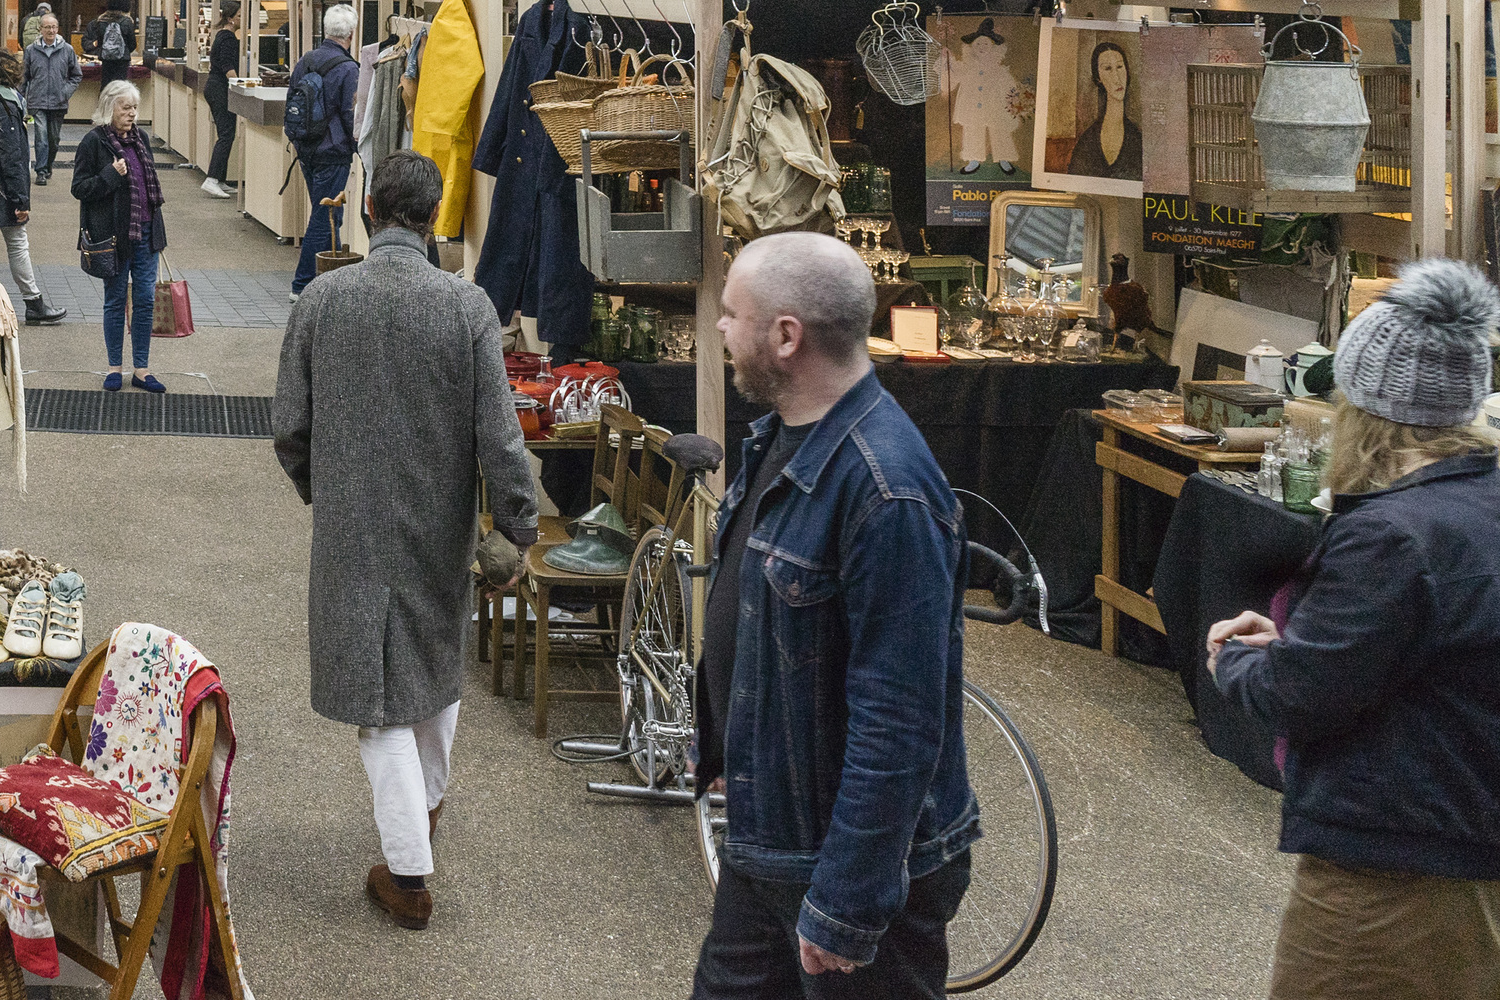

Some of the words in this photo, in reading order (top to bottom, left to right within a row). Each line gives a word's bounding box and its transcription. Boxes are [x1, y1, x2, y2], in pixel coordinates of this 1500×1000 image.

[952, 189, 988, 202] Pablo
[1211, 204, 1264, 227] KLEE
[1151, 232, 1213, 246] FONDATION
[1216, 238, 1256, 250] MAEGHT
